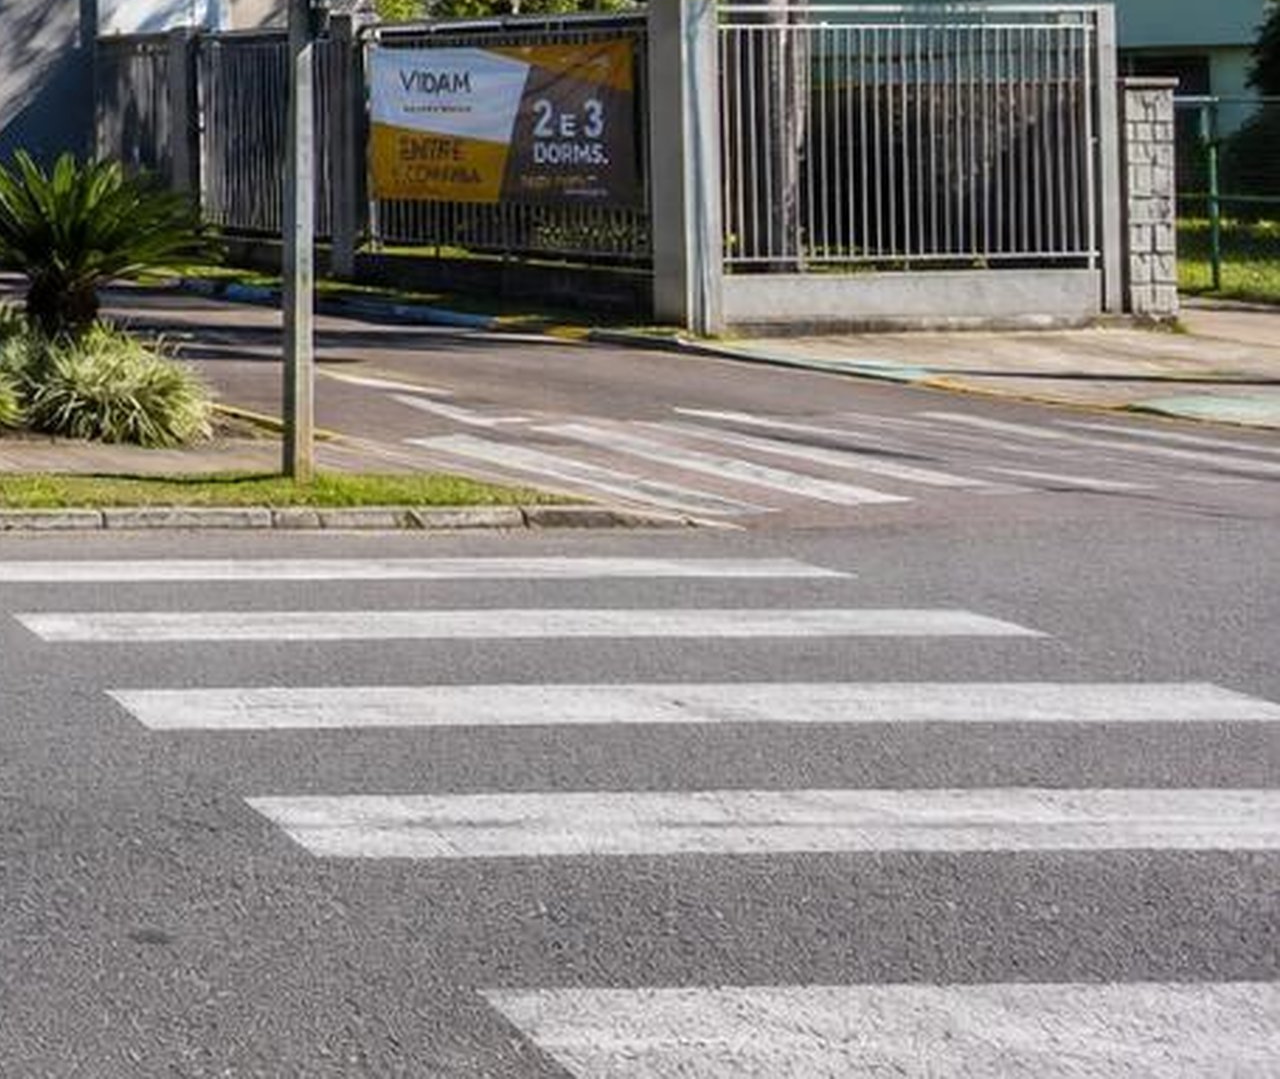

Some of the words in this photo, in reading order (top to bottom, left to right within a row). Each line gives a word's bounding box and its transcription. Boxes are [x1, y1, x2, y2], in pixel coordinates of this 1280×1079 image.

[533, 99, 553, 137] 2
[560, 113, 577, 137] E
[584, 99, 604, 138] 3
[533, 142, 610, 165] DORMS.
